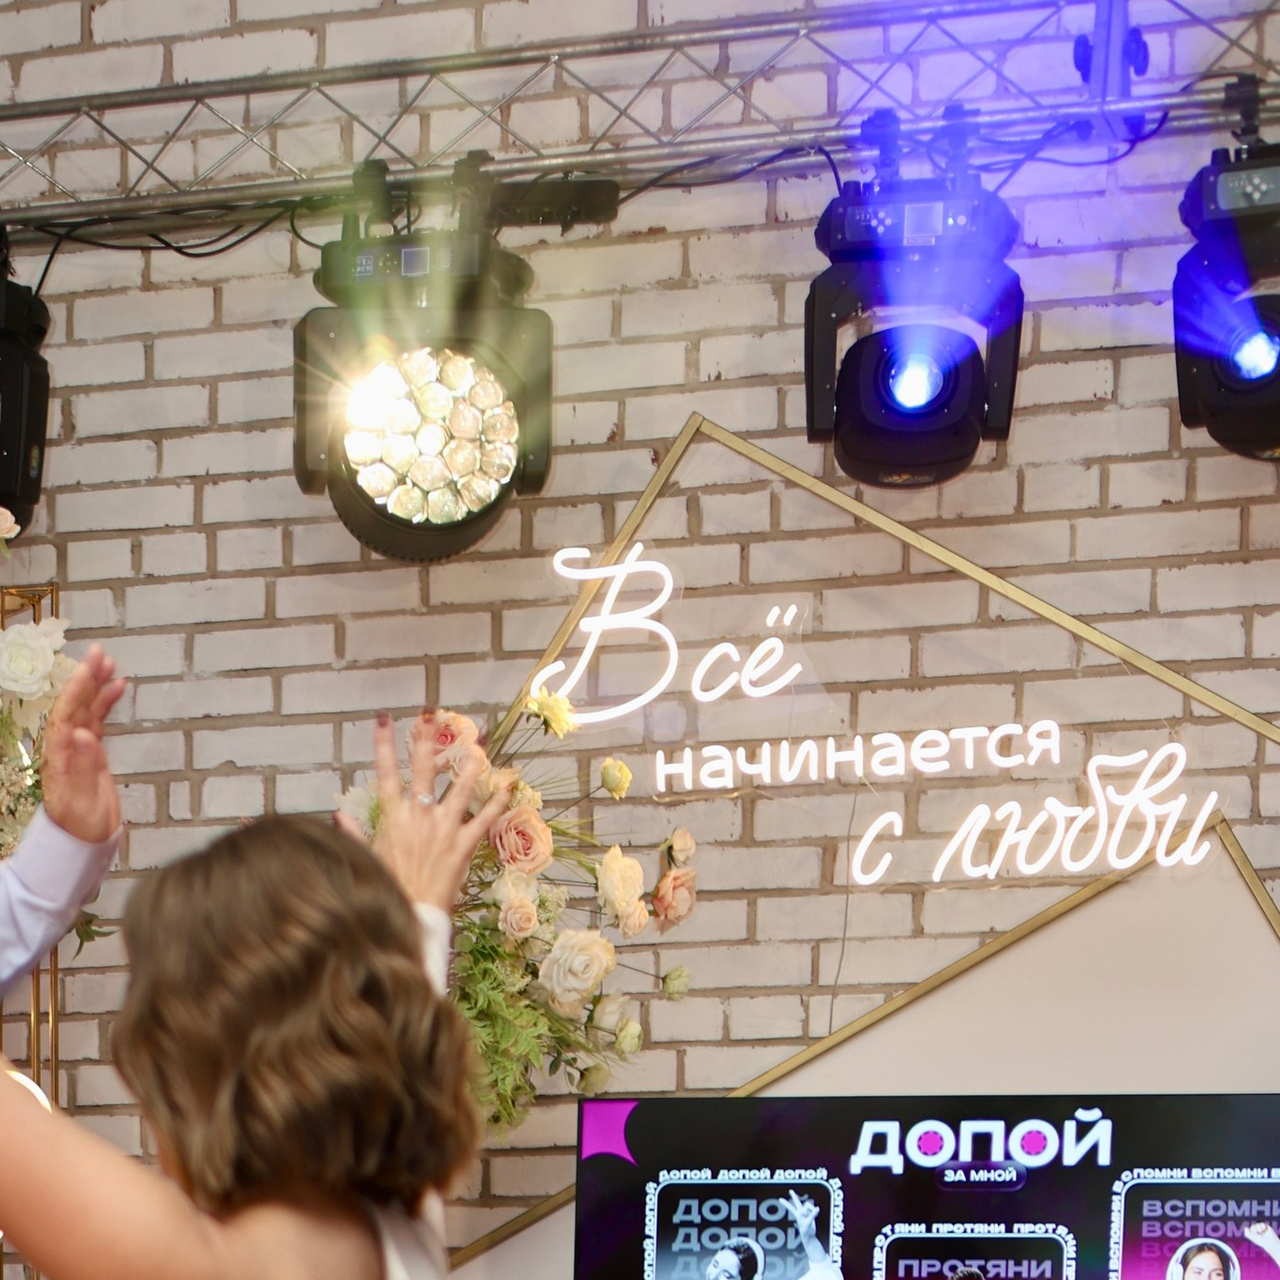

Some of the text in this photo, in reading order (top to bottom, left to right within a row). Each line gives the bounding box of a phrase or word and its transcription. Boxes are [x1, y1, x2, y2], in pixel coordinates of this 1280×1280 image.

[531, 542, 802, 724] Всё
[655, 718, 1062, 793] начинается
[851, 741, 1219, 885] с любви
[850, 1107, 1113, 1175] ДОПОЙ
[659, 1167, 828, 1182] ДОПОЙ ДОПОЙ ДОПОЙ
[943, 1167, 1017, 1182] ЗА МНОЙ
[645, 1181, 657, 1237] ДОПОЙ
[828, 1177, 845, 1233] ДОПОЙ
[932, 1223, 1006, 1234] ПРОТЯНИ
